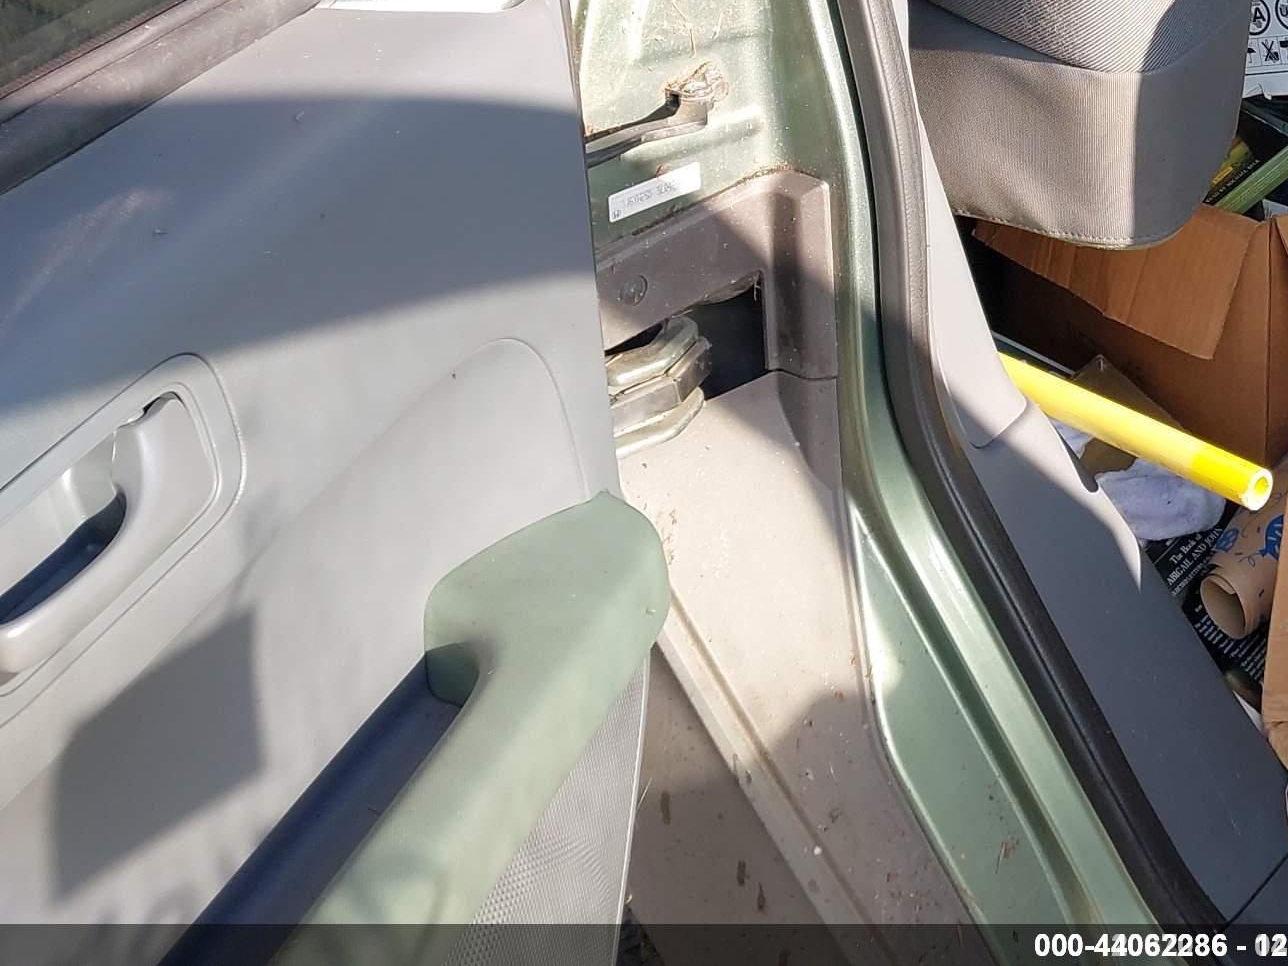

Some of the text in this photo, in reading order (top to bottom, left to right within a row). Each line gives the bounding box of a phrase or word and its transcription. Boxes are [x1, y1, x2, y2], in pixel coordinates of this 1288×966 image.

[1166, 558, 1194, 586] ABIGAIL
[1191, 543, 1207, 560] AND
[1169, 552, 1184, 565] The
[1180, 538, 1197, 554] Book
